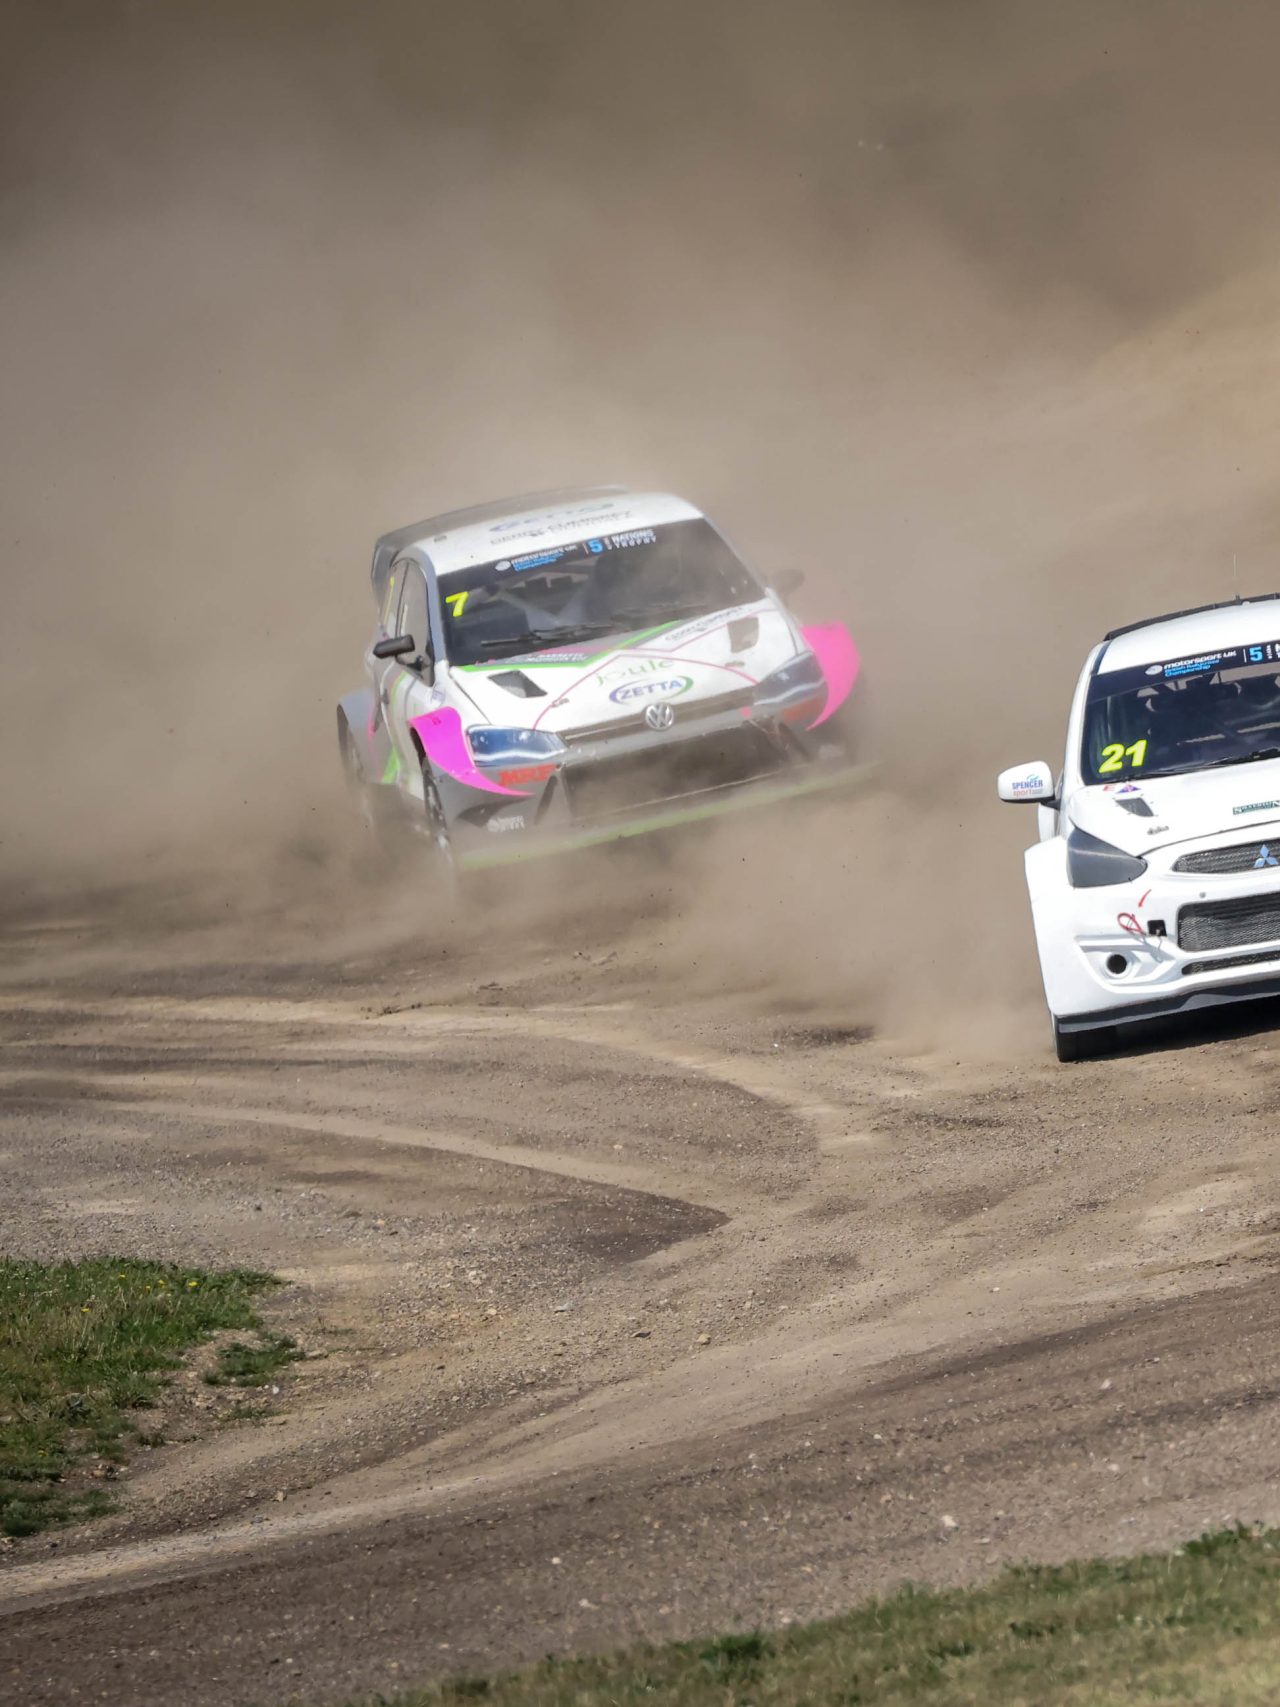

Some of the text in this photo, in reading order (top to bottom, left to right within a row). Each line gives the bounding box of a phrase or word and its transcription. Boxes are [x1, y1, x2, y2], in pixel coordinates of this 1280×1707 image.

[588, 538, 603, 553] 5
[445, 591, 468, 617] 7
[1163, 650, 1236, 670] motorsport UK
[1249, 647, 1263, 662] 5
[618, 680, 684, 700] ZETTA
[1098, 739, 1147, 773] 21
[1012, 779, 1044, 790] SPENCER
